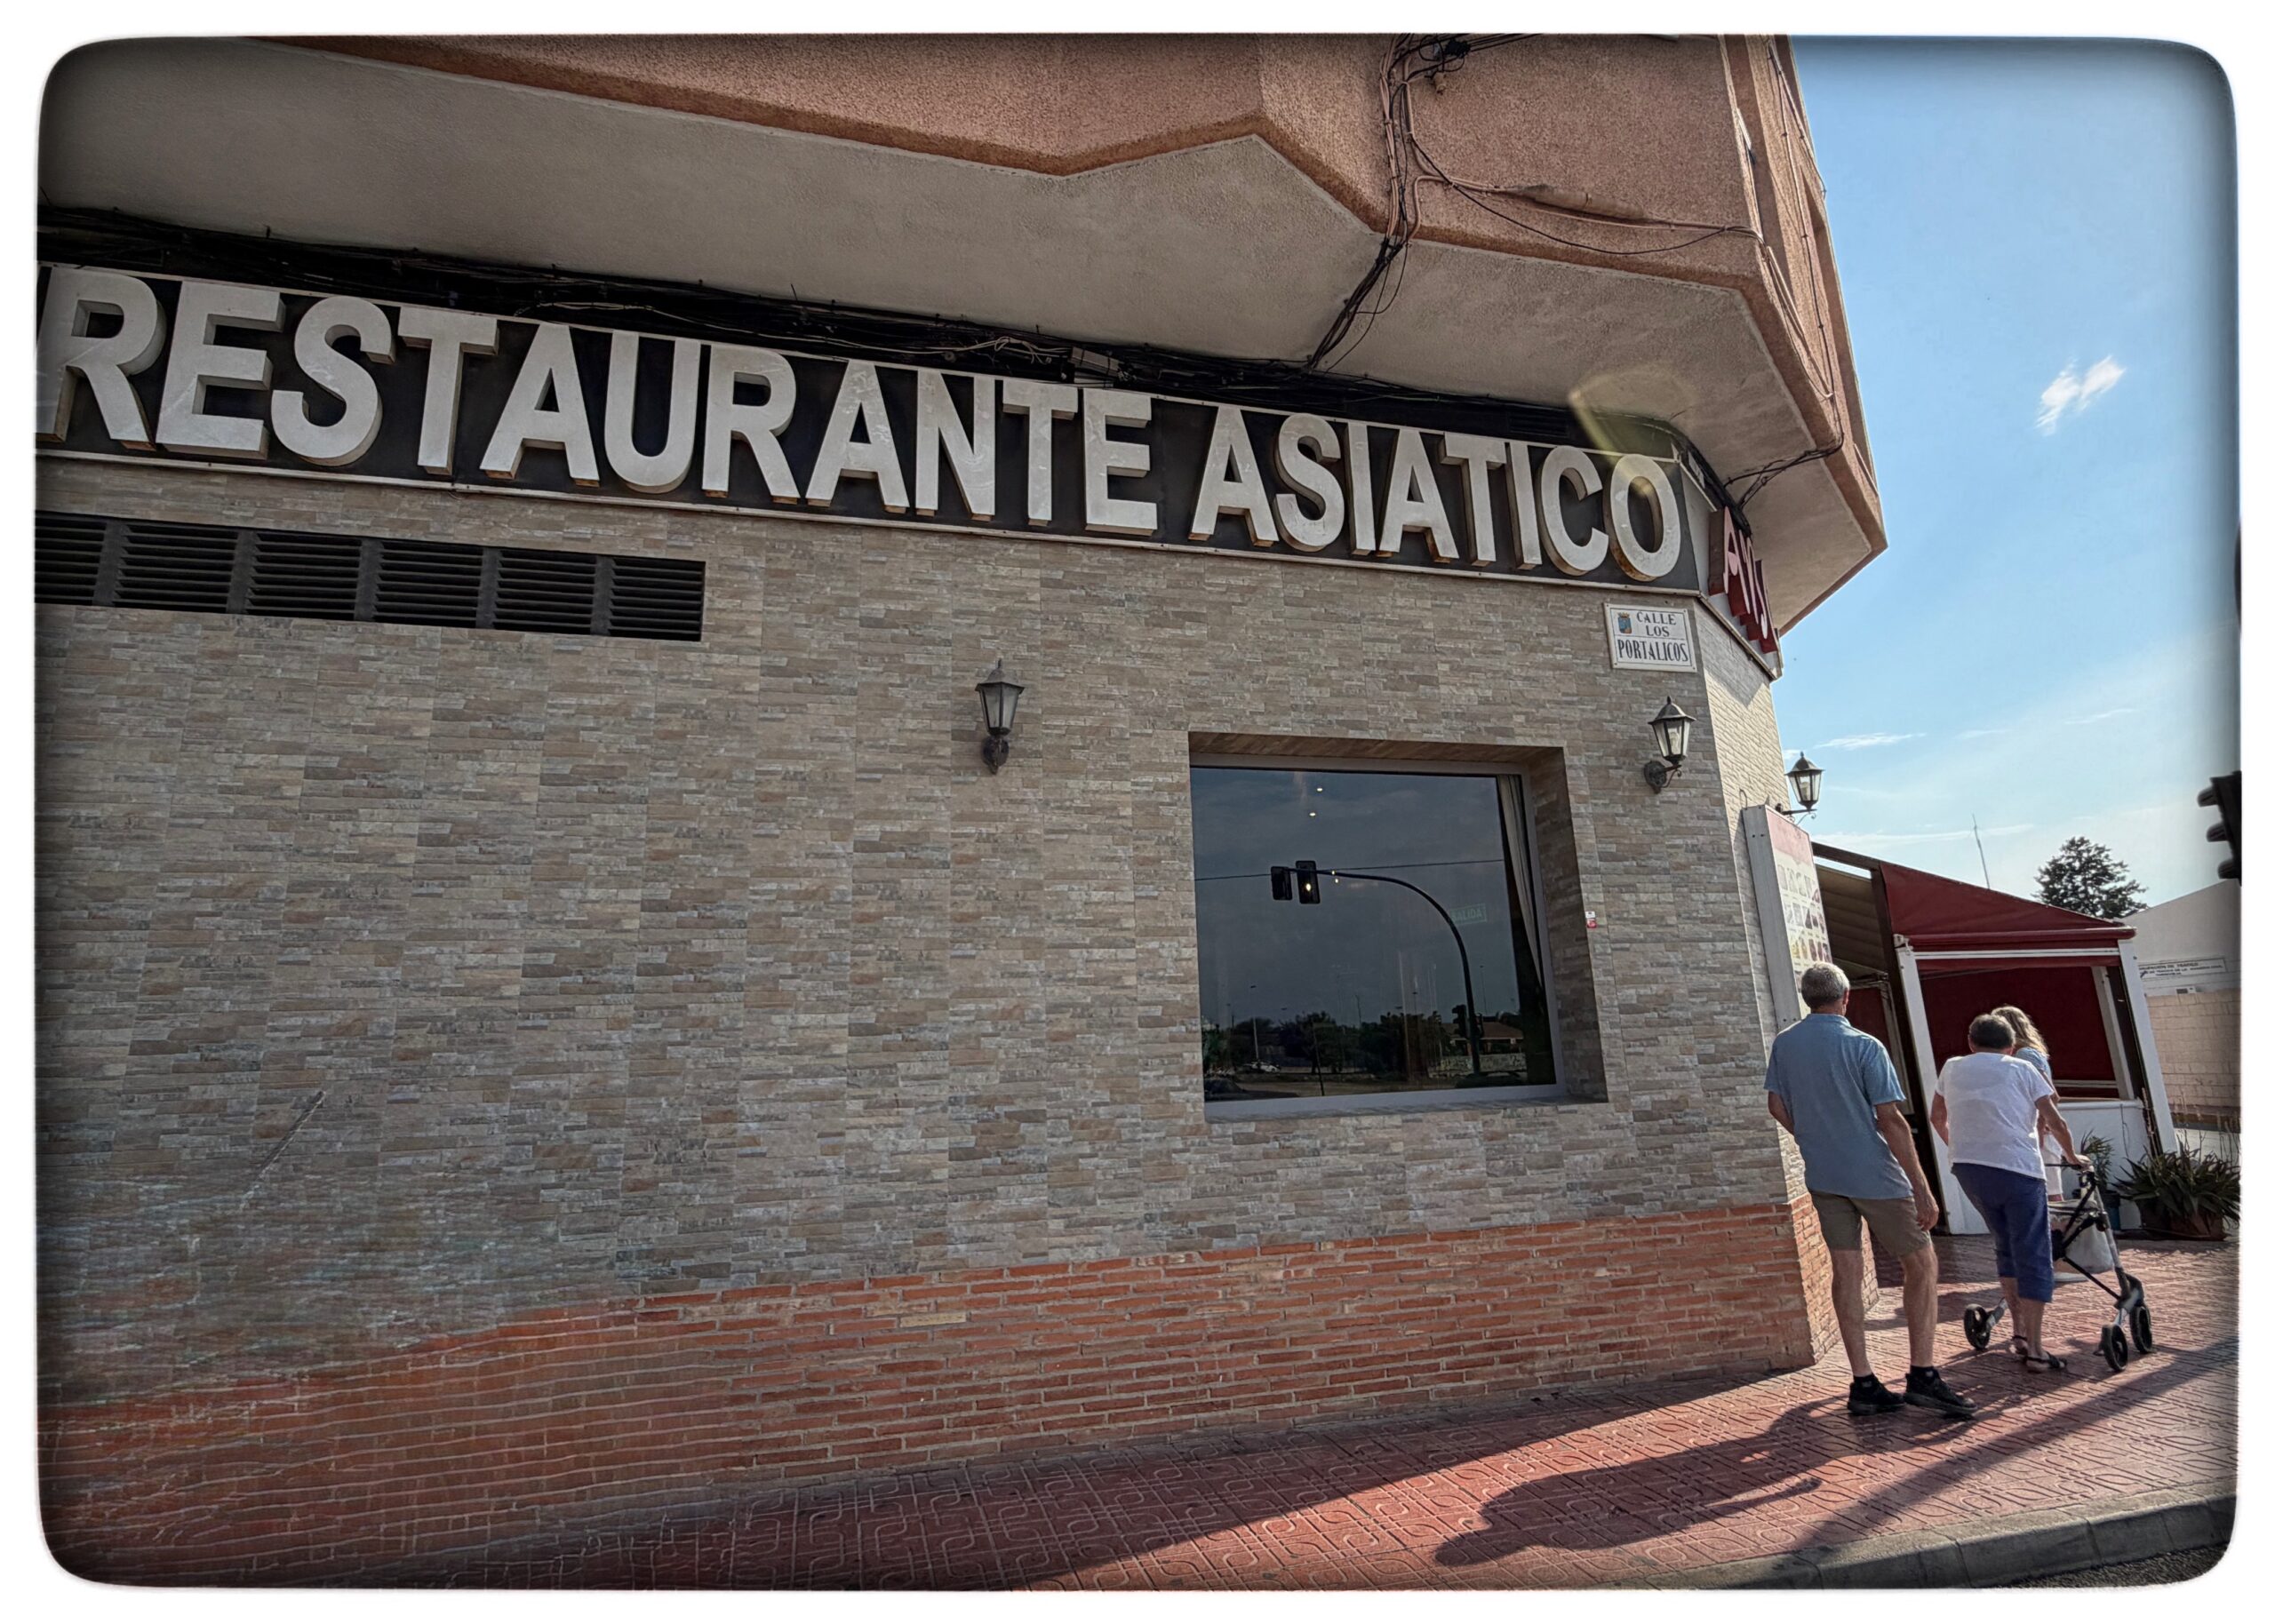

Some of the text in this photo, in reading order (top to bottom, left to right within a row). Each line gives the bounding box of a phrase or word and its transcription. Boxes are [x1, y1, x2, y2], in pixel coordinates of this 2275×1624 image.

[36, 267, 1158, 535] RESTAURANTE
[1189, 406, 1680, 581] ASIATICO
[1636, 611, 1677, 625] CALLE
[1646, 625, 1670, 637] LOS
[1617, 639, 1688, 662] PORTALICOS
